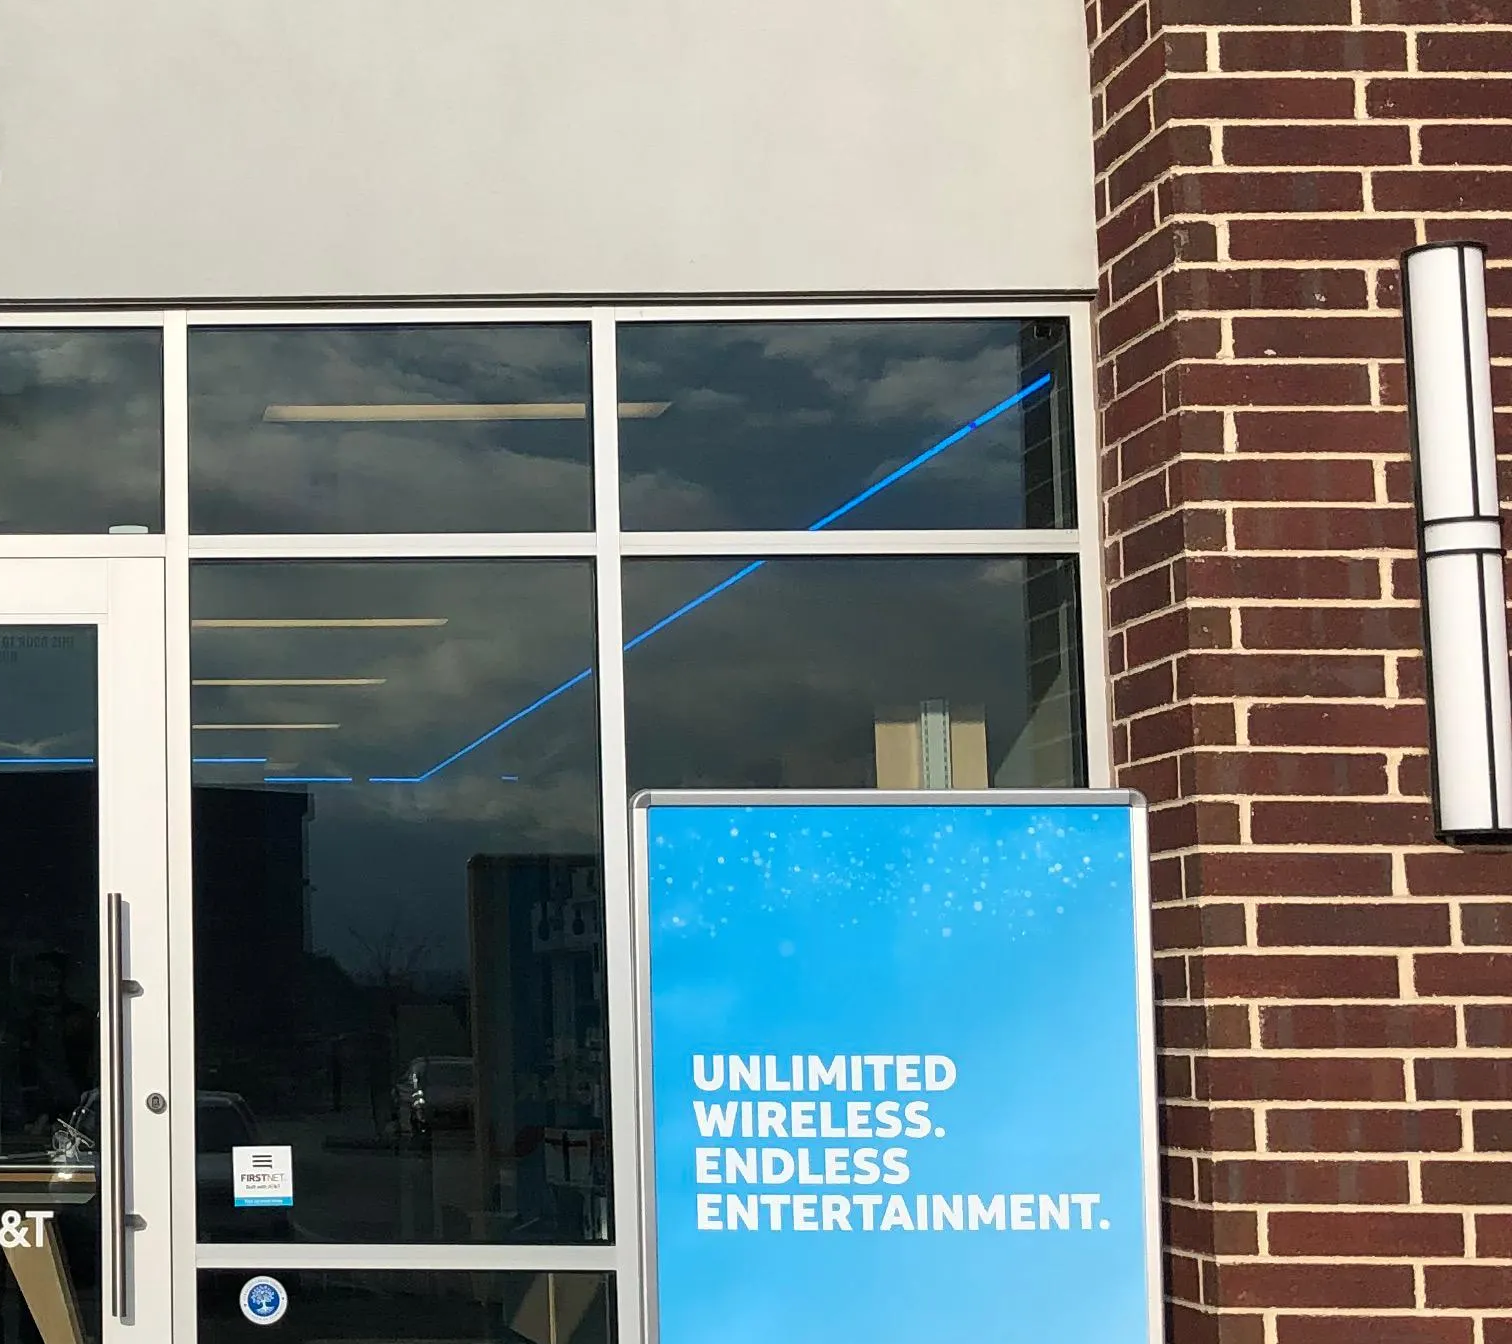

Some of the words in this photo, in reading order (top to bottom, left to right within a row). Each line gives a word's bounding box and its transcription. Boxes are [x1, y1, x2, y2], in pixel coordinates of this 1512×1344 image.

[692, 1054, 957, 1092] UNLIMITED
[692, 1100, 946, 1139] WIRELESS.
[695, 1147, 911, 1186] ENDLESS
[696, 1193, 1112, 1233] ENTERTAINMENT.
